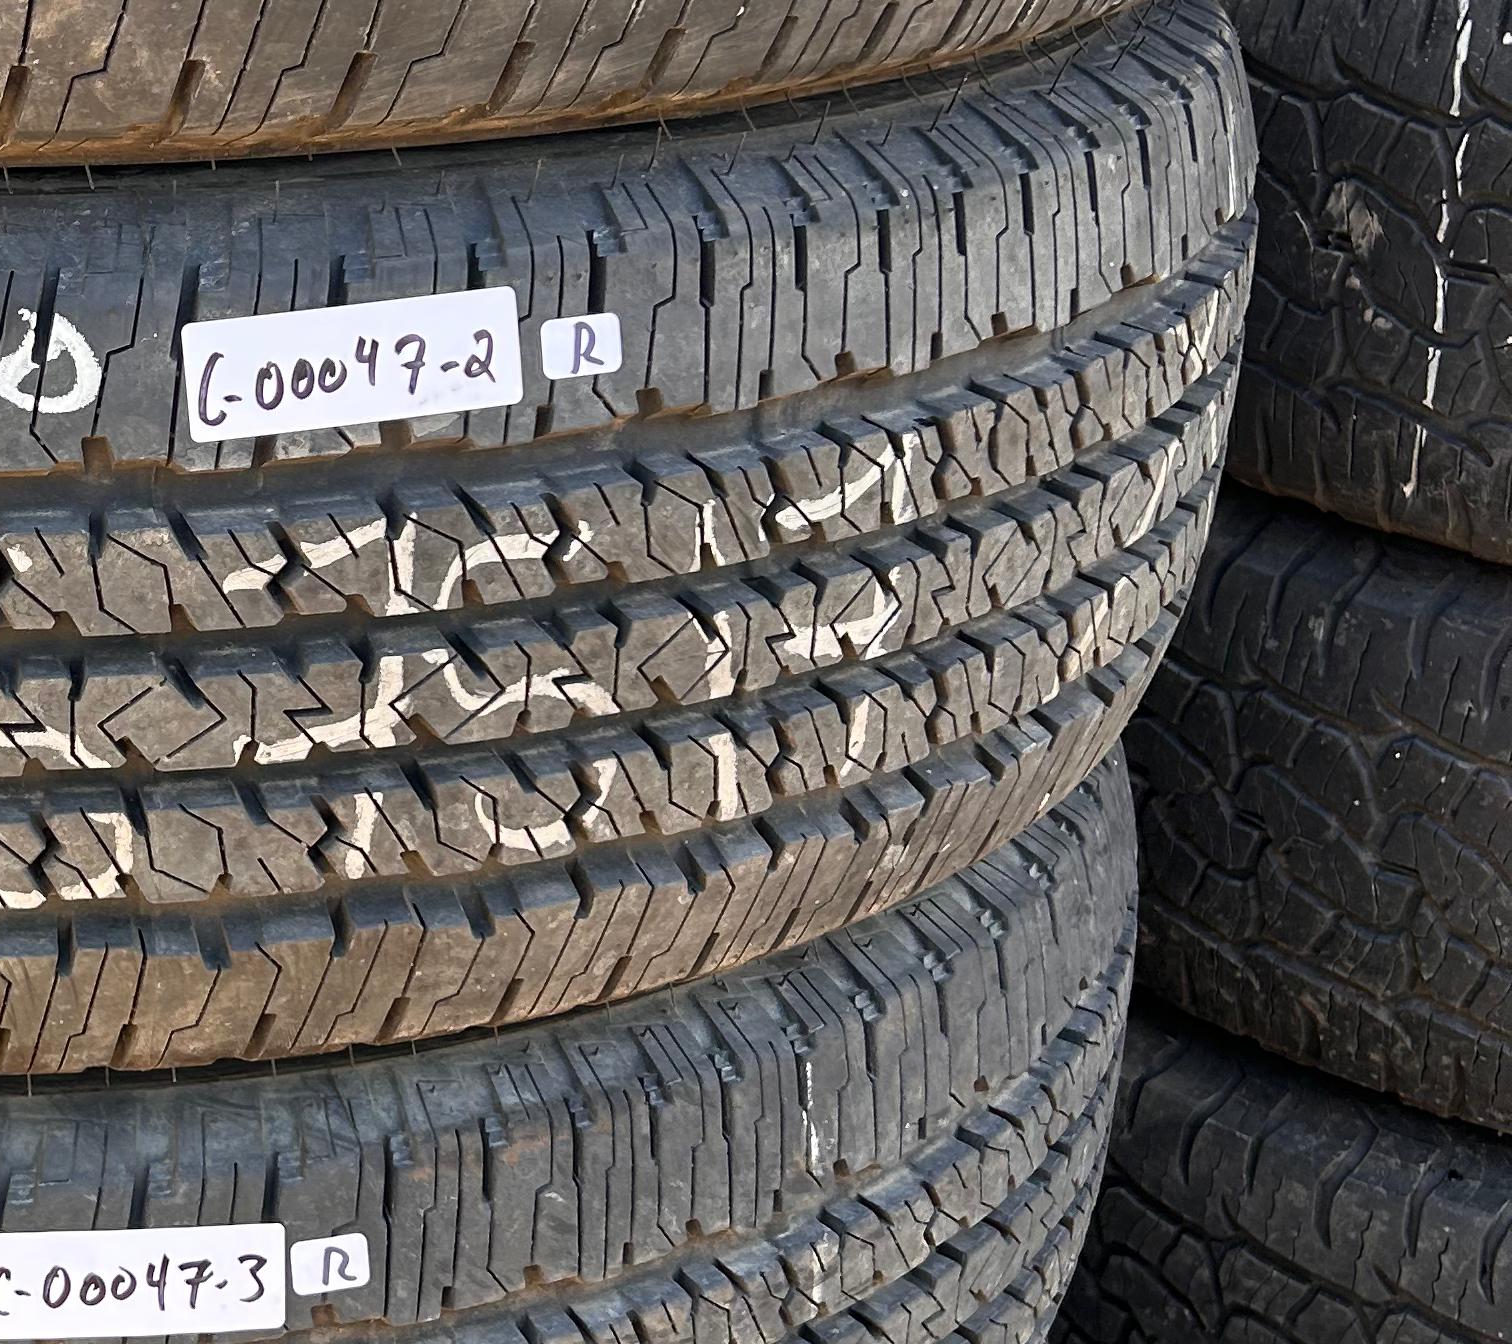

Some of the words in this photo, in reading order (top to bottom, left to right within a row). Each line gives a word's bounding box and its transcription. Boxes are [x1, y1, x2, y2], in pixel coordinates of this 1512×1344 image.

[570, 321, 605, 374] R
[197, 329, 497, 427] C-00047-2
[322, 1246, 357, 1285] R
